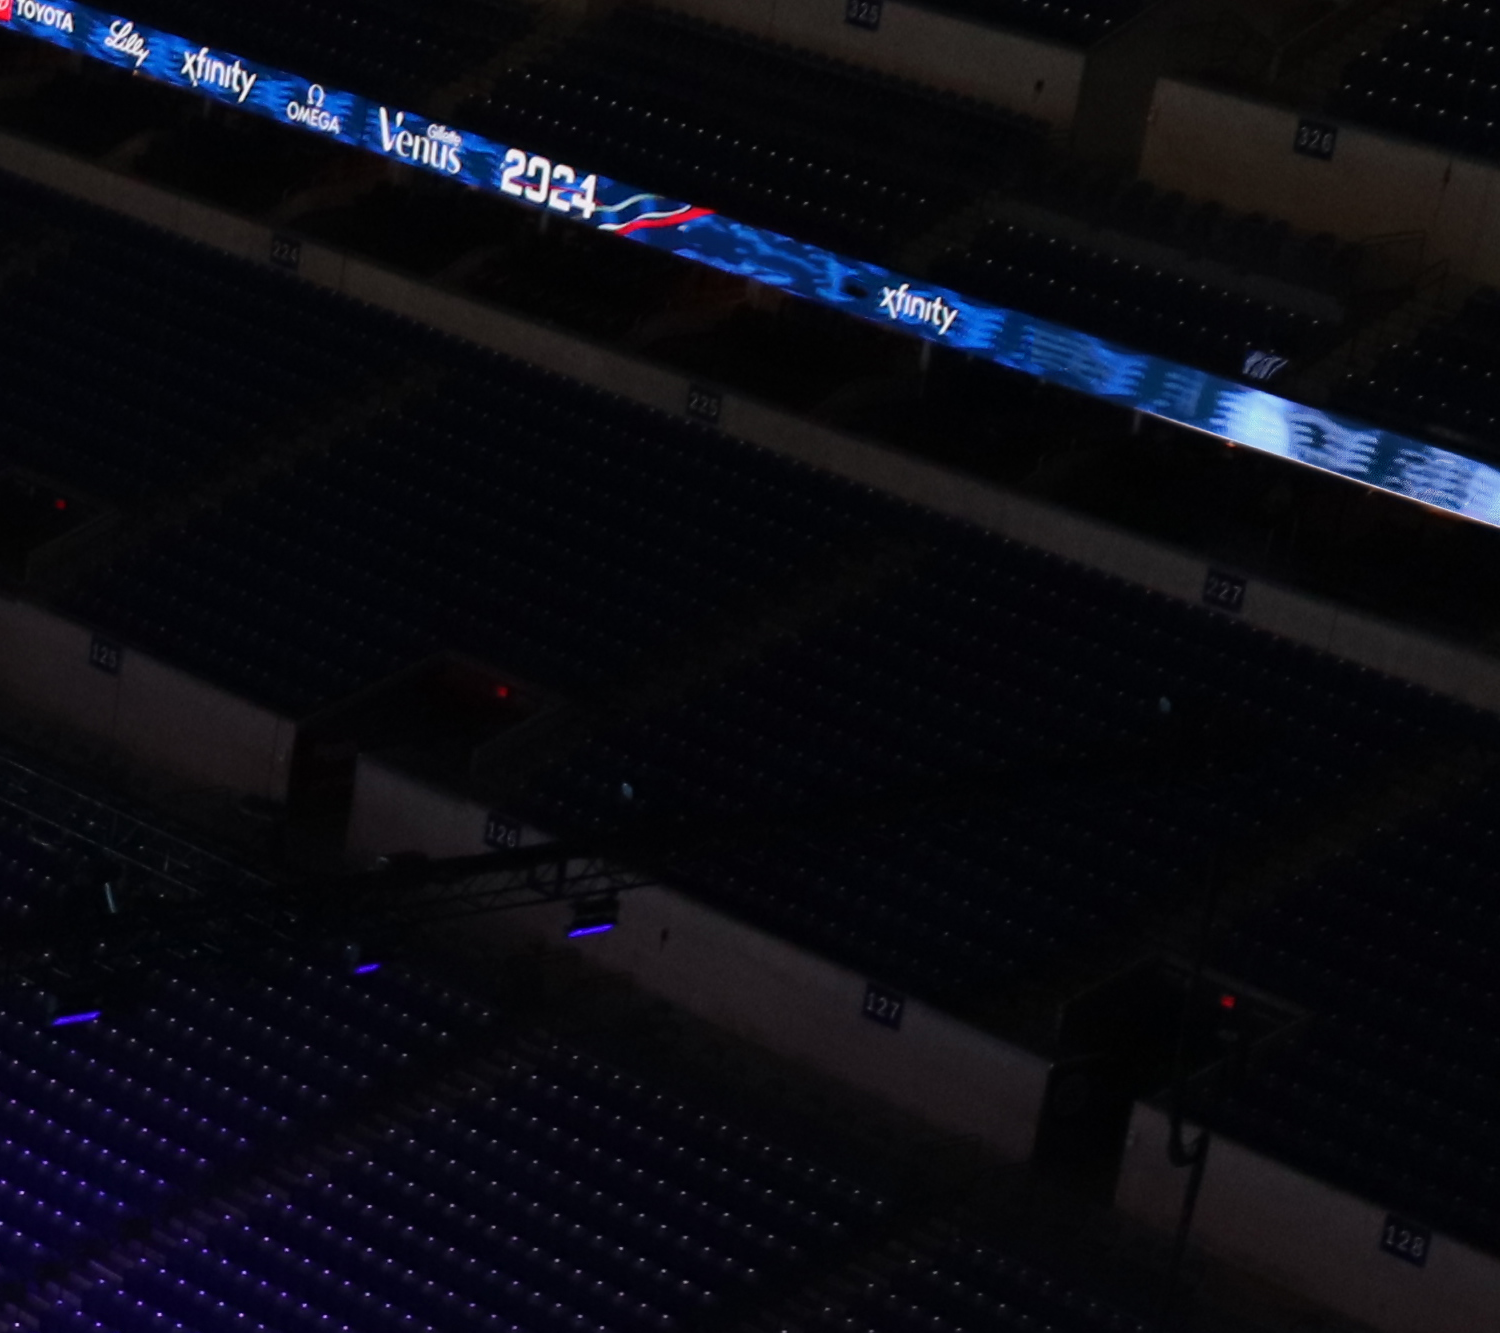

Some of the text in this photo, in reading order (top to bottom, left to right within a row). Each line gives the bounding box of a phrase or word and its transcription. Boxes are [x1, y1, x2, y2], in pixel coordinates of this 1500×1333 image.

[16, 0, 74, 33] TOYOTA
[849, 0, 878, 23] 325
[105, 20, 150, 66] Lilly
[180, 47, 257, 103] xfinity
[287, 101, 341, 135] OMEGA
[377, 106, 462, 175] Venus
[426, 123, 462, 147] Gillette
[1299, 126, 1333, 154] 326
[499, 147, 598, 219] 2024
[879, 283, 959, 336] xfinity
[1207, 577, 1242, 605] 227
[91, 643, 117, 668] 125
[488, 821, 516, 848] 126
[866, 993, 900, 1020] 127
[1387, 1226, 1425, 1258] 128
